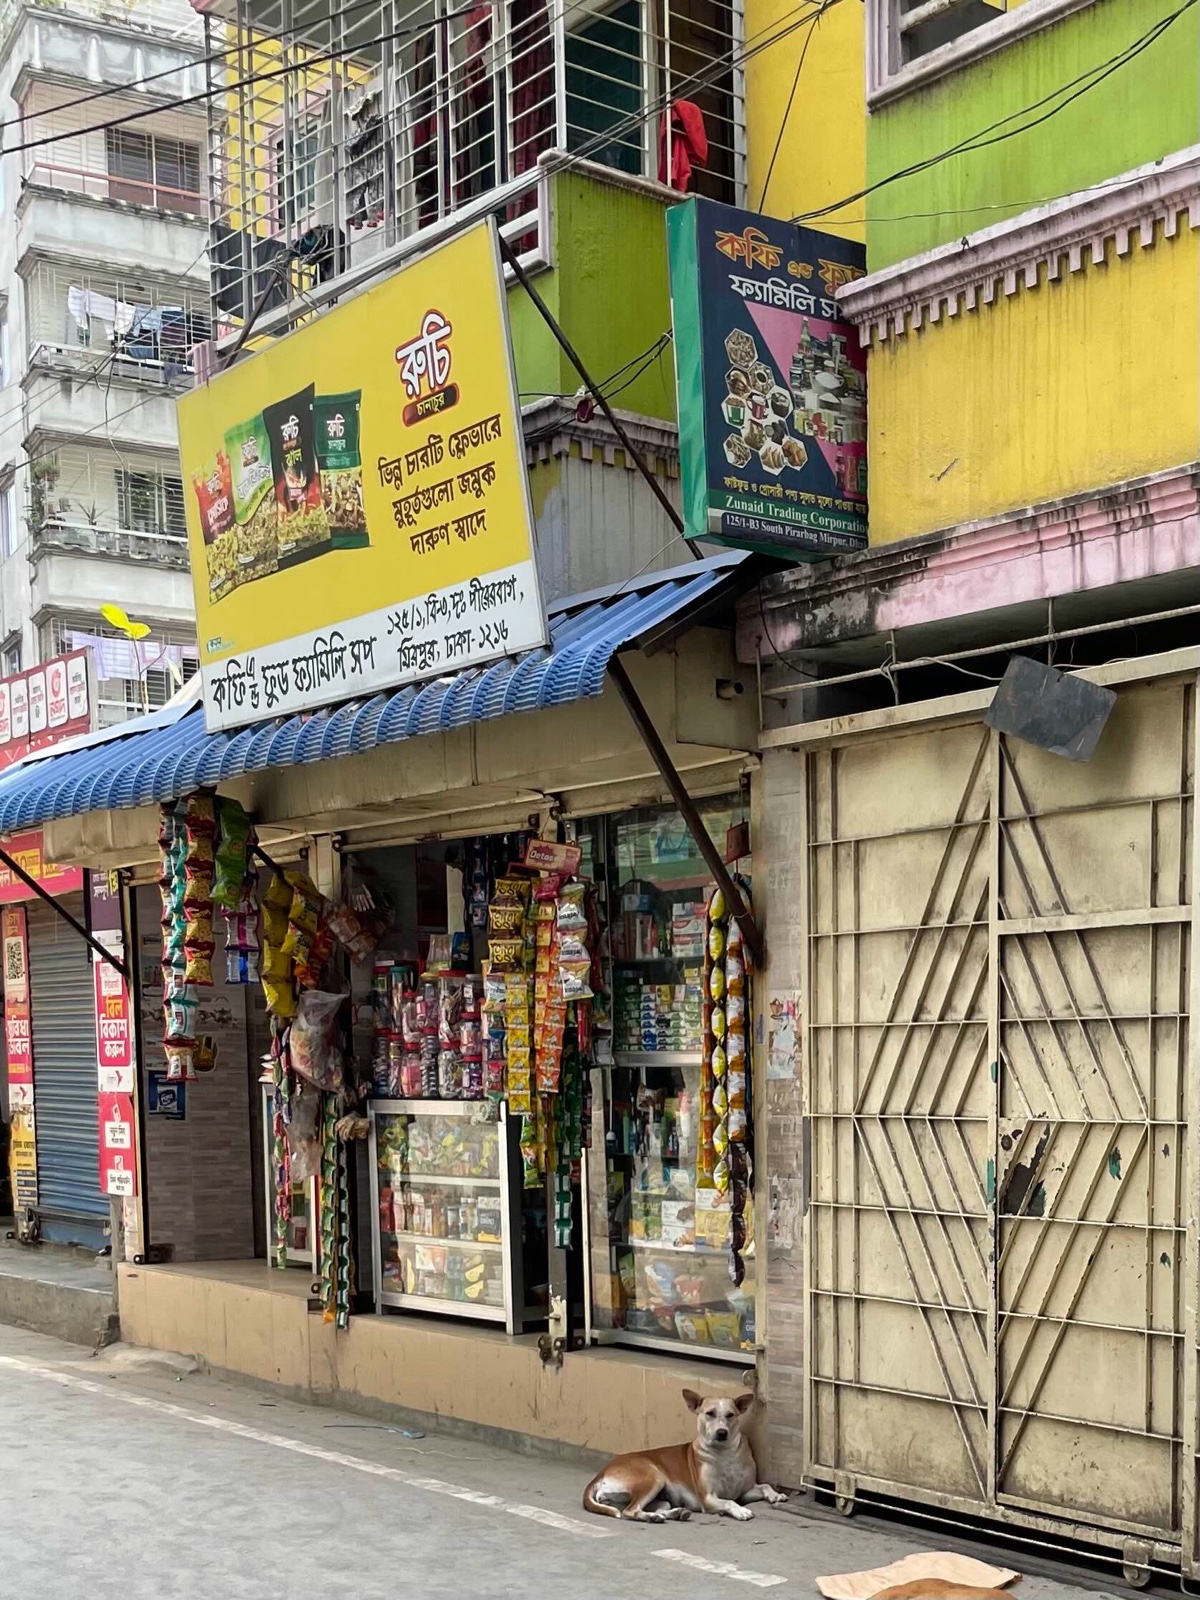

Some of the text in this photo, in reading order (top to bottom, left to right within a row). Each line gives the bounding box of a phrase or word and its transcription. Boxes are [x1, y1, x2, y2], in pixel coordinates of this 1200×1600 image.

[714, 226, 784, 270] কফি
[729, 275, 844, 320] ফ্যামিলি স
[396, 312, 452, 397] রুচি
[417, 392, 445, 416] চানাচুর
[281, 415, 299, 441] রুচি
[327, 413, 345, 437] রুচি
[284, 449, 302, 467] ঝাল
[378, 414, 502, 491] ভিন্ন চারটি ফ্লেভারে
[392, 461, 496, 529] মুহূর্তগুলো জমুক
[725, 495, 764, 514] Zunaid
[766, 503, 808, 524] Trading
[410, 509, 487, 555] দারুণ স্বাদে
[726, 514, 760, 530] 125/1-B3
[761, 522, 784, 535] South
[785, 525, 818, 542] Pirarbag
[478, 620, 508, 650] ১২১৬
[210, 659, 245, 713] কফি
[261, 659, 289, 708] ফুড
[292, 630, 348, 692] ফ্যামিলি
[349, 635, 377, 675] সপ
[106, 995, 123, 1018] বিল
[100, 1013, 128, 1039] বিকাশ
[104, 1040, 125, 1058] করুন
